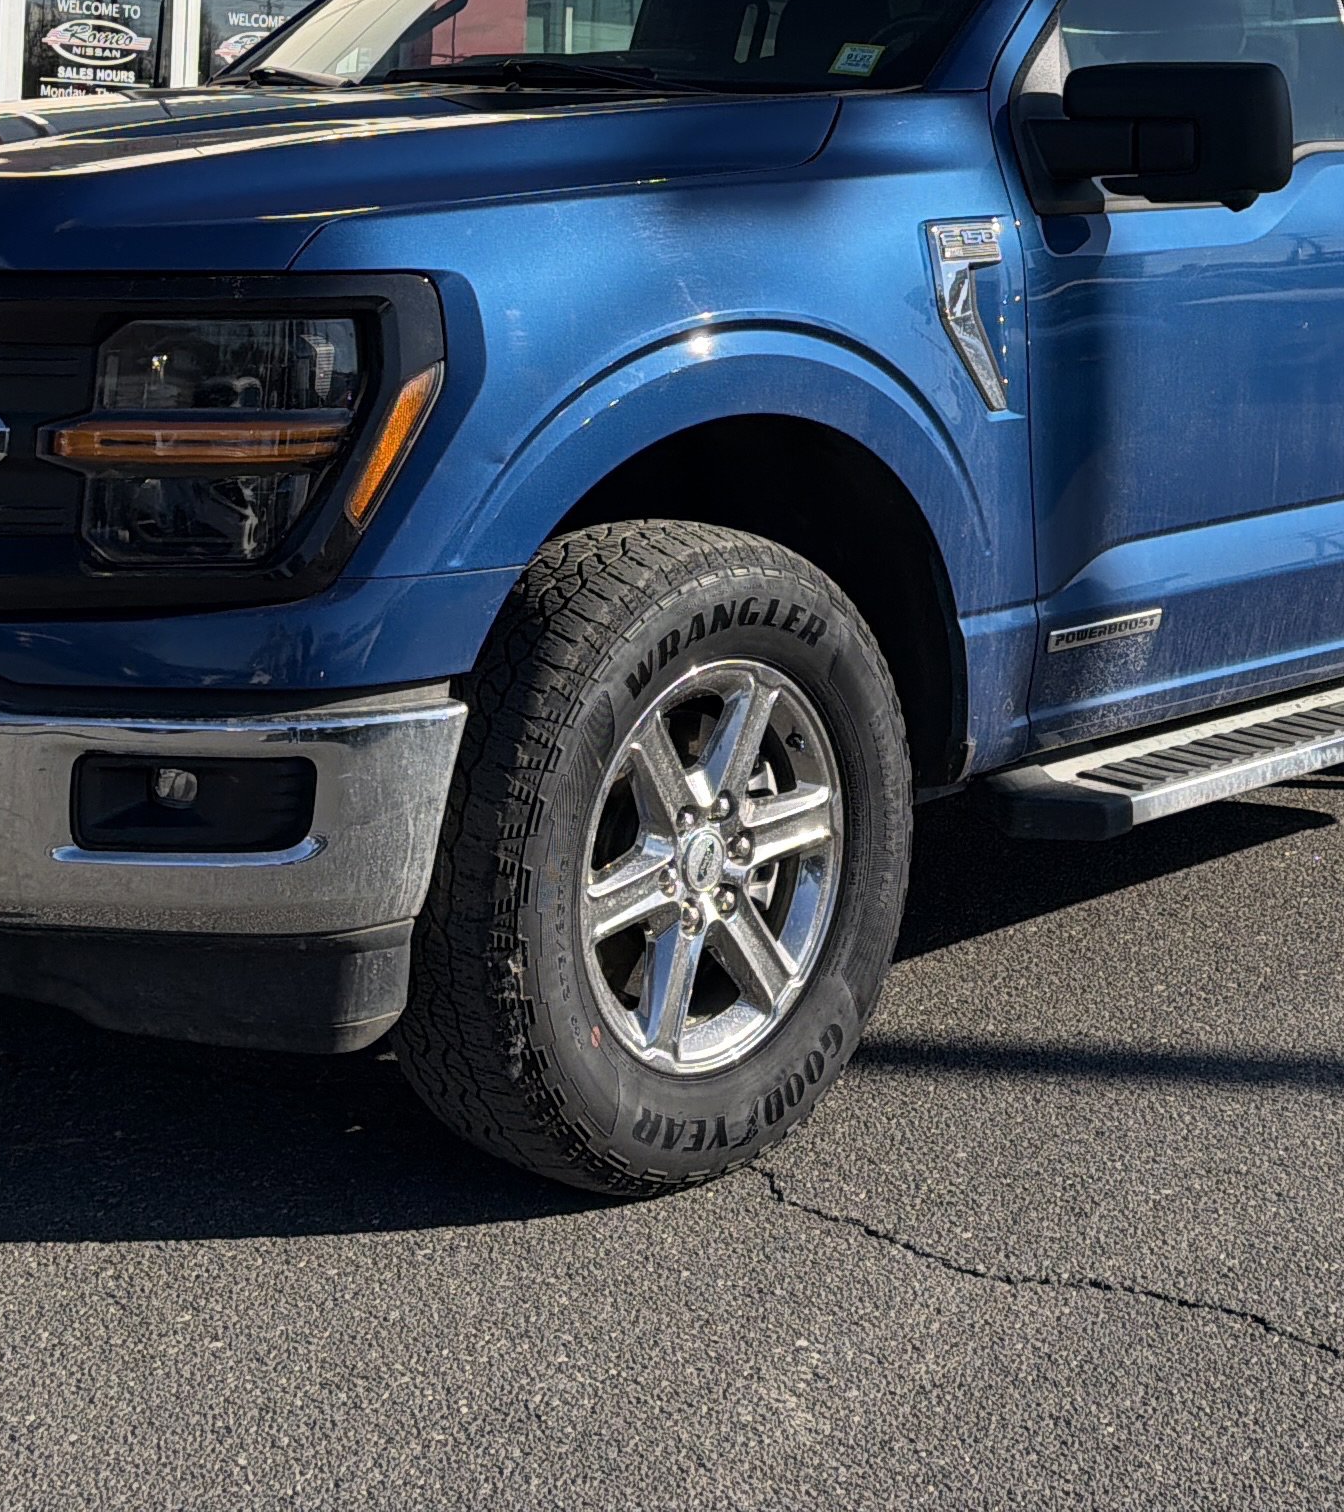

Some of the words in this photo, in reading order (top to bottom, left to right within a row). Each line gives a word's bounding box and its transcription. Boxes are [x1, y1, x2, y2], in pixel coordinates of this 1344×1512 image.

[122, 4, 141, 19] TO
[228, 11, 285, 28] WELCOME
[63, 22, 134, 47] Romeo
[72, 46, 121, 58] NISSAN
[57, 65, 94, 81] SALES
[96, 68, 136, 84] HOURS
[939, 229, 998, 246] F-150
[1054, 617, 1156, 647] POWERBOOST
[624, 595, 828, 701] WRANGLER
